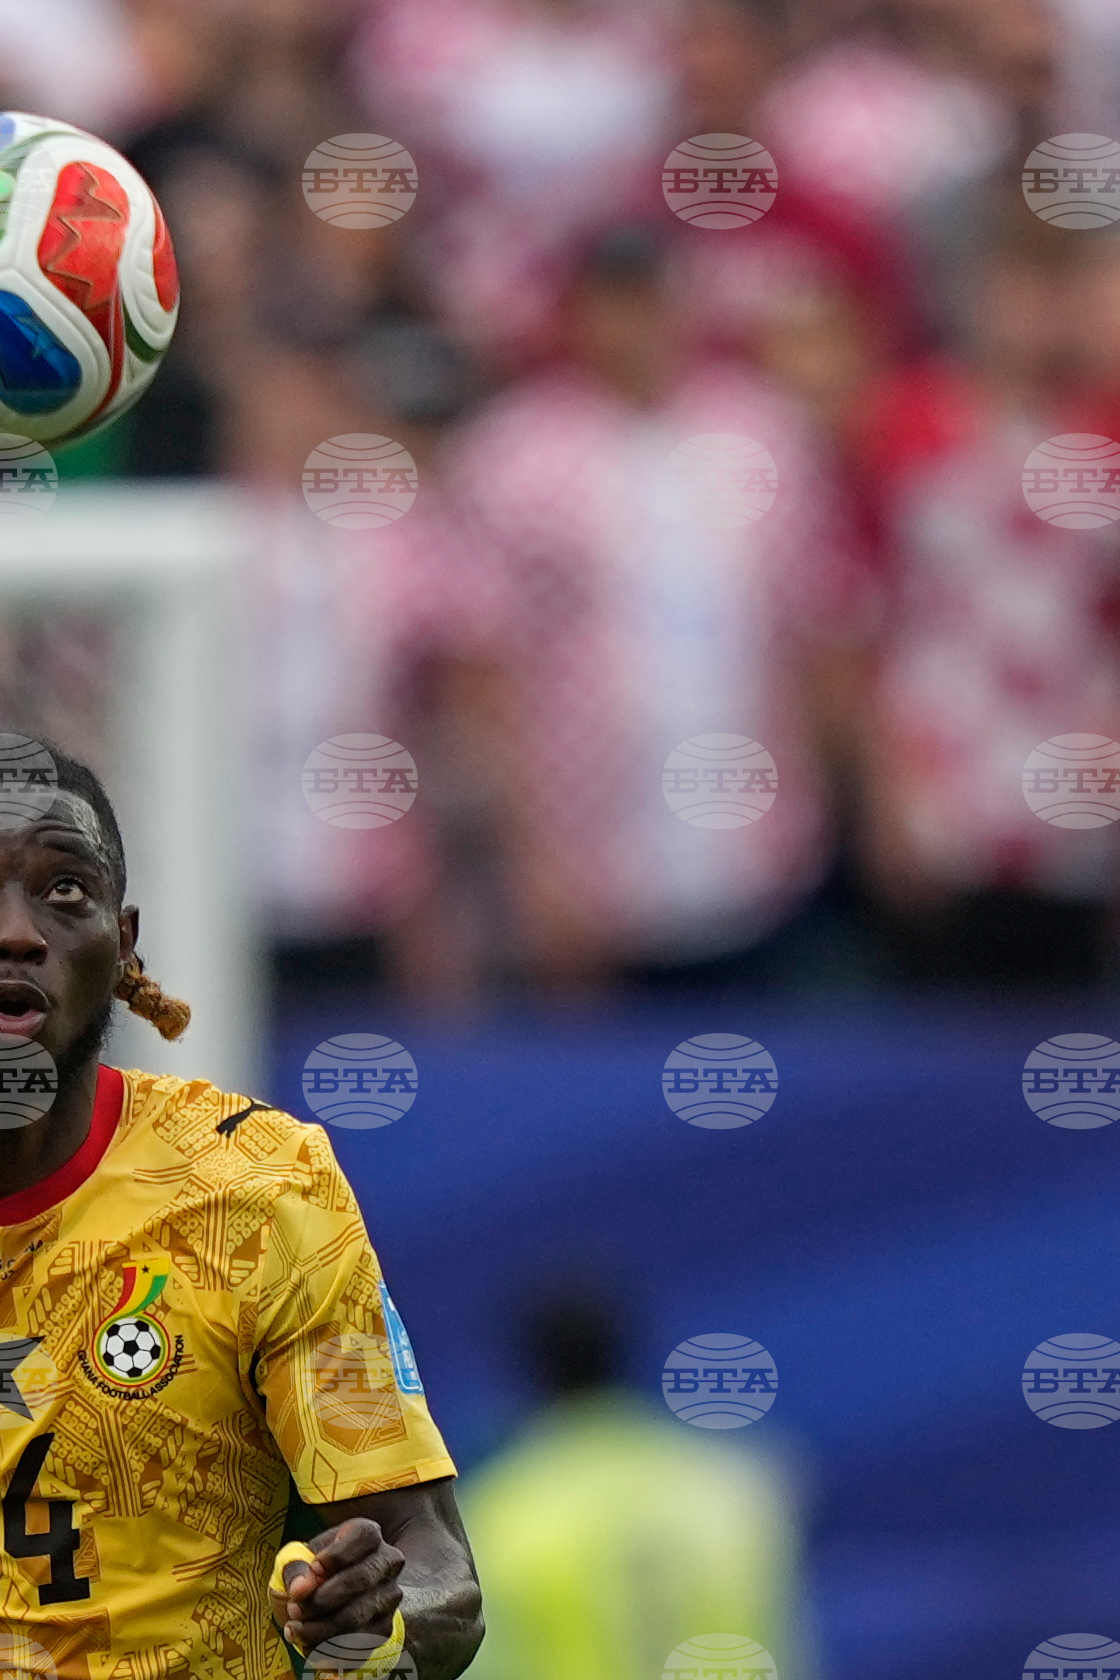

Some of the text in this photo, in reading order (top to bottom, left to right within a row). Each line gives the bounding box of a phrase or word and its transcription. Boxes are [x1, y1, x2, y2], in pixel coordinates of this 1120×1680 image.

[78, 1335, 184, 1400] GHANA FOOTBALL ASSOCIATION
